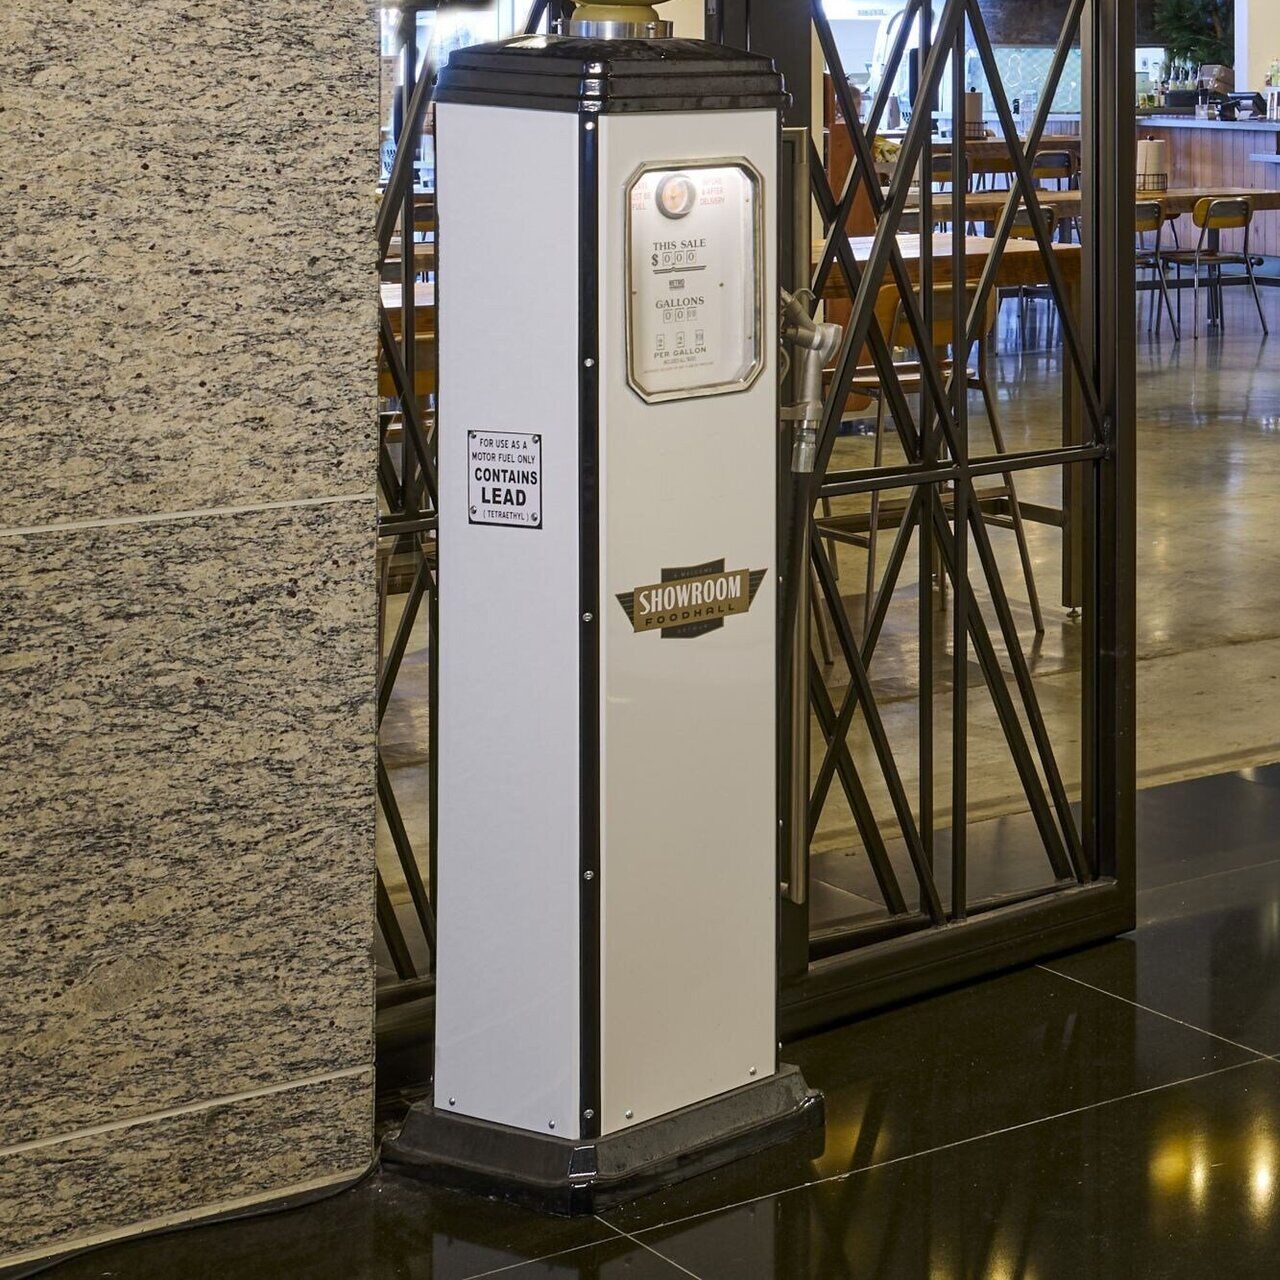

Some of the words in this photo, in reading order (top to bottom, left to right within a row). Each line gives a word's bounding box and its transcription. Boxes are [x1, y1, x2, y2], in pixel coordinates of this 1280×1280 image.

[653, 240, 677, 251] THIS
[680, 238, 707, 249] SALE
[655, 296, 705, 309] GALLONS
[653, 351, 670, 359] PER
[673, 346, 707, 357] GALLON
[479, 438, 494, 448] FOR
[495, 439, 509, 448] USE
[511, 440, 521, 450] AS
[522, 440, 528, 450] A
[471, 451, 496, 462] MOTOR
[498, 453, 515, 463] FUEL
[517, 455, 536, 464] ONLY
[474, 467, 538, 485] CONTAINS
[481, 486, 527, 506] LEAD
[638, 574, 741, 615] SHOWROOM
[645, 603, 735, 626] FOODHALL
